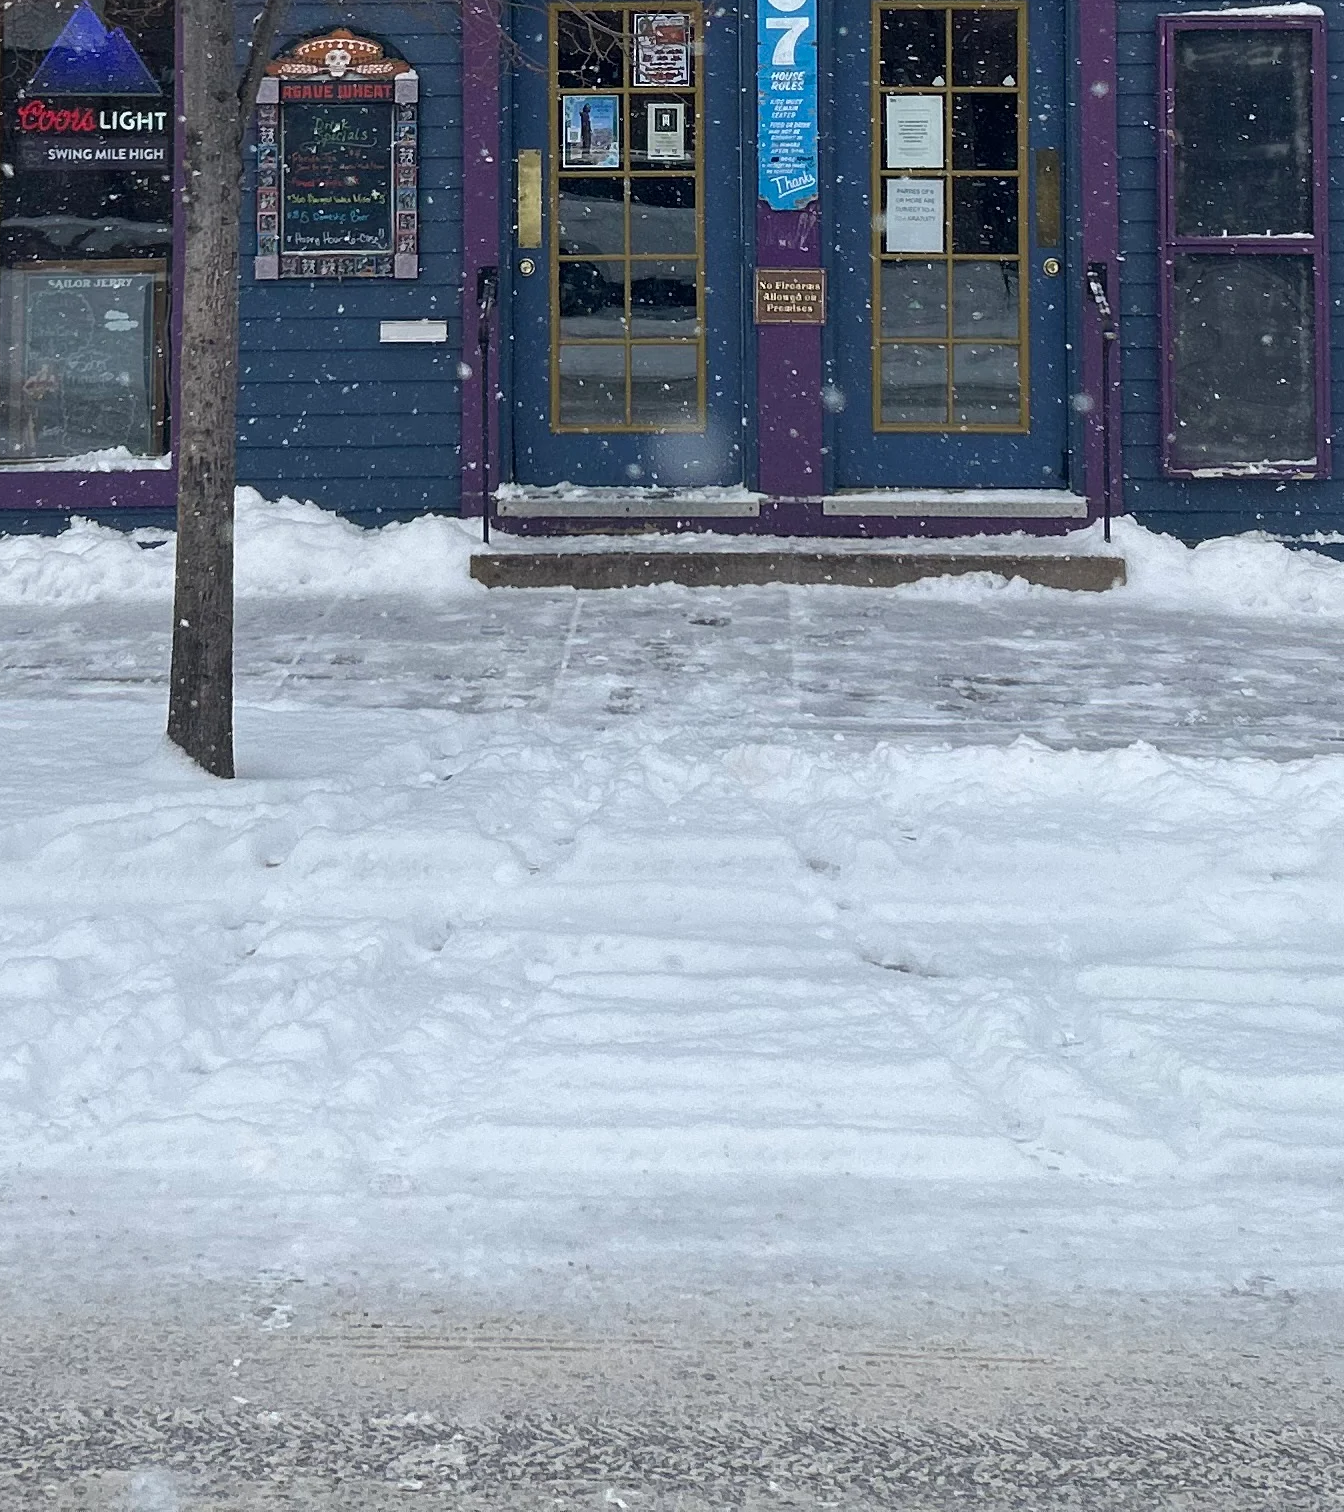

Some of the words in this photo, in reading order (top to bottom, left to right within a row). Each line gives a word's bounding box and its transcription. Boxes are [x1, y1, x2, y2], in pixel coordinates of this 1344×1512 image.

[770, 71, 806, 81] HOUSE
[770, 80, 805, 91] RULES
[282, 85, 334, 99] AGAVE
[338, 84, 393, 99] WHEAT
[18, 100, 97, 132] Coors
[99, 110, 167, 131] LIGHT
[316, 129, 368, 147] Specials
[47, 148, 93, 160] SWING
[95, 148, 127, 160] MILE
[129, 148, 164, 160] HIGH
[47, 279, 91, 289] SAILOR
[94, 278, 133, 288] JERRY
[759, 281, 773, 290] No
[775, 281, 821, 290] Firearms
[763, 292, 803, 302] Allowed
[766, 303, 813, 312] Premises
